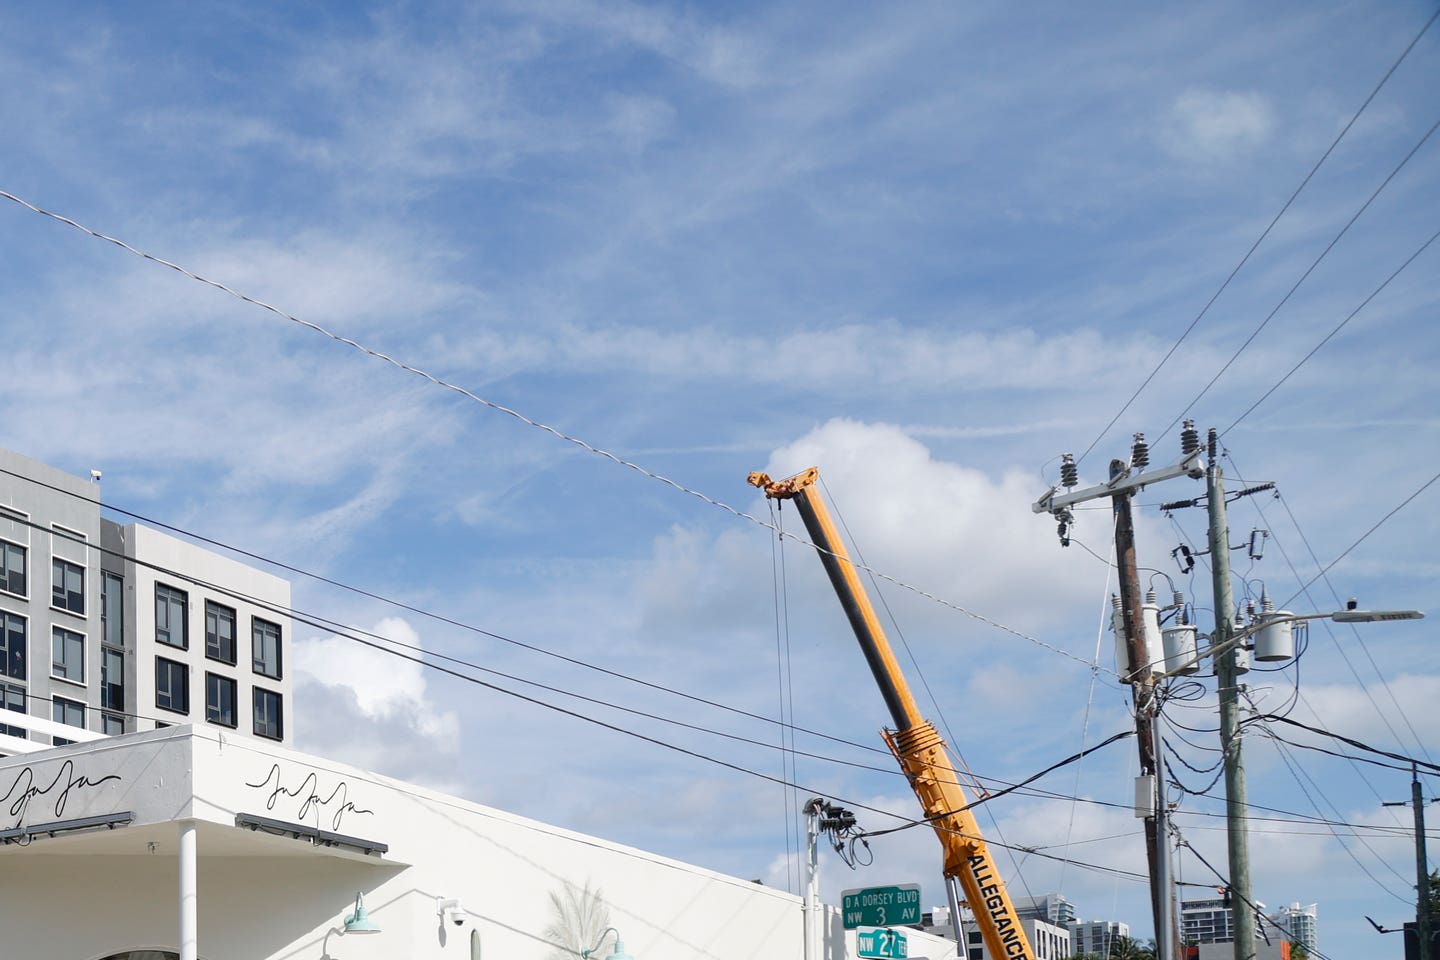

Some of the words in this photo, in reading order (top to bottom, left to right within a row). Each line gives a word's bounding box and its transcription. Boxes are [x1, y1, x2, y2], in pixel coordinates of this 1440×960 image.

[845, 897, 851, 909] D
[853, 896, 860, 908] A
[862, 892, 894, 907] DORSEY
[897, 890, 917, 904] BLVD
[847, 911, 863, 924] NW
[876, 906, 887, 926] 3
[901, 907, 916, 920] AV
[859, 936, 874, 953] NW
[879, 933, 896, 957] 27
